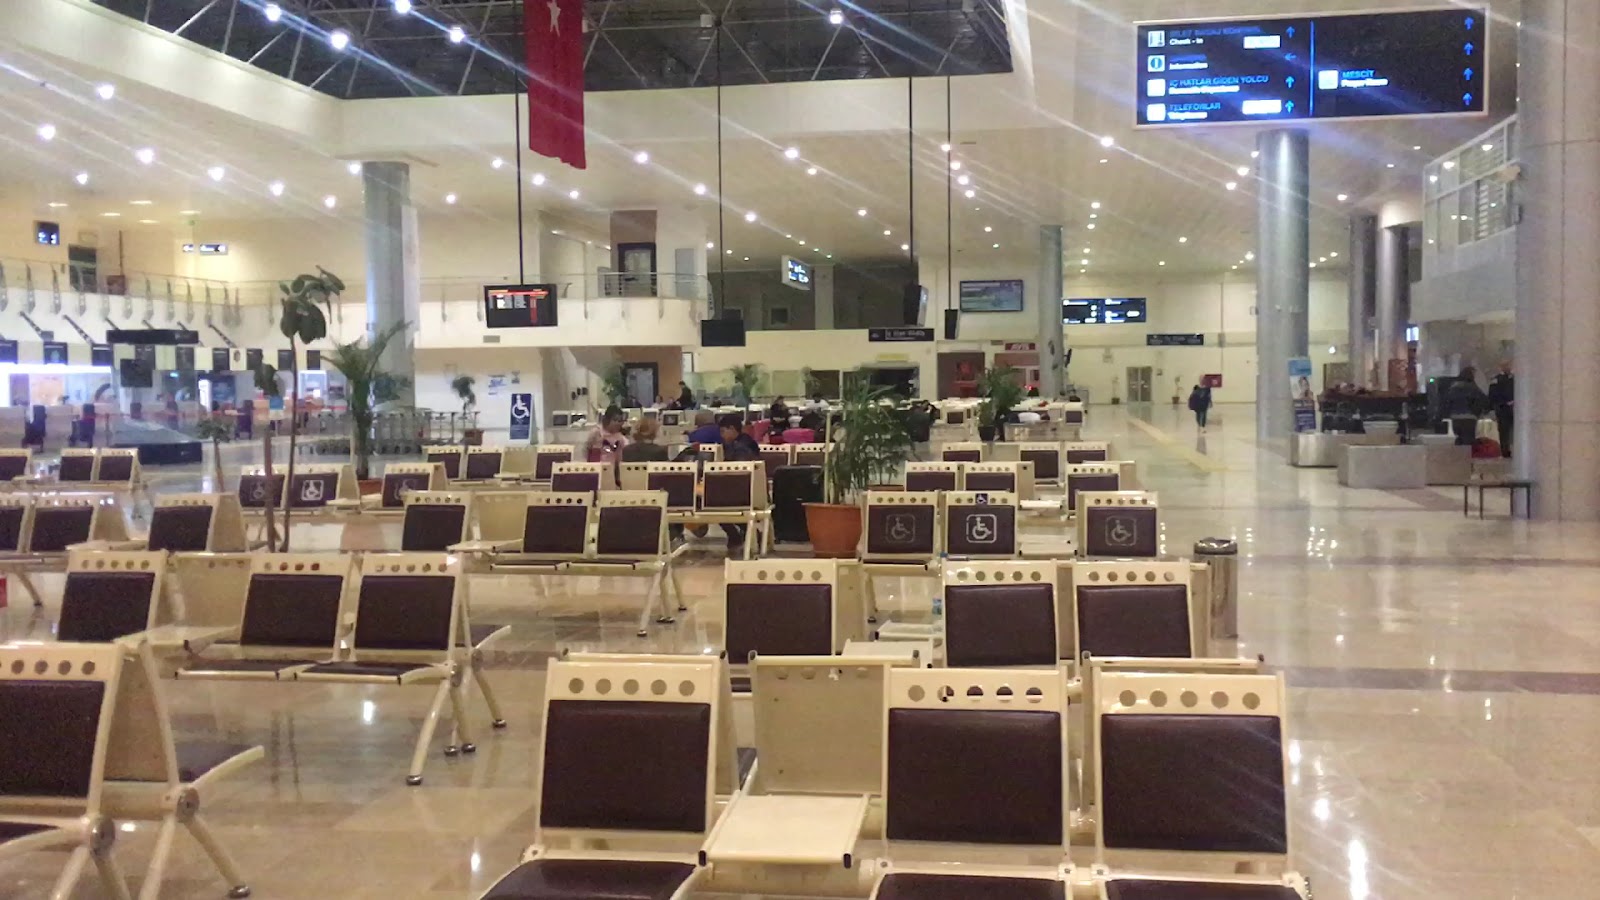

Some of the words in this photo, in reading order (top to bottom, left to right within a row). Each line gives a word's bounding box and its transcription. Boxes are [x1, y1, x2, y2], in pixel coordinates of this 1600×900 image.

[1180, 78, 1211, 87] HATLAR
[1241, 75, 1268, 84] YOLCU
[1170, 102, 1220, 111] TELEFONLAR
